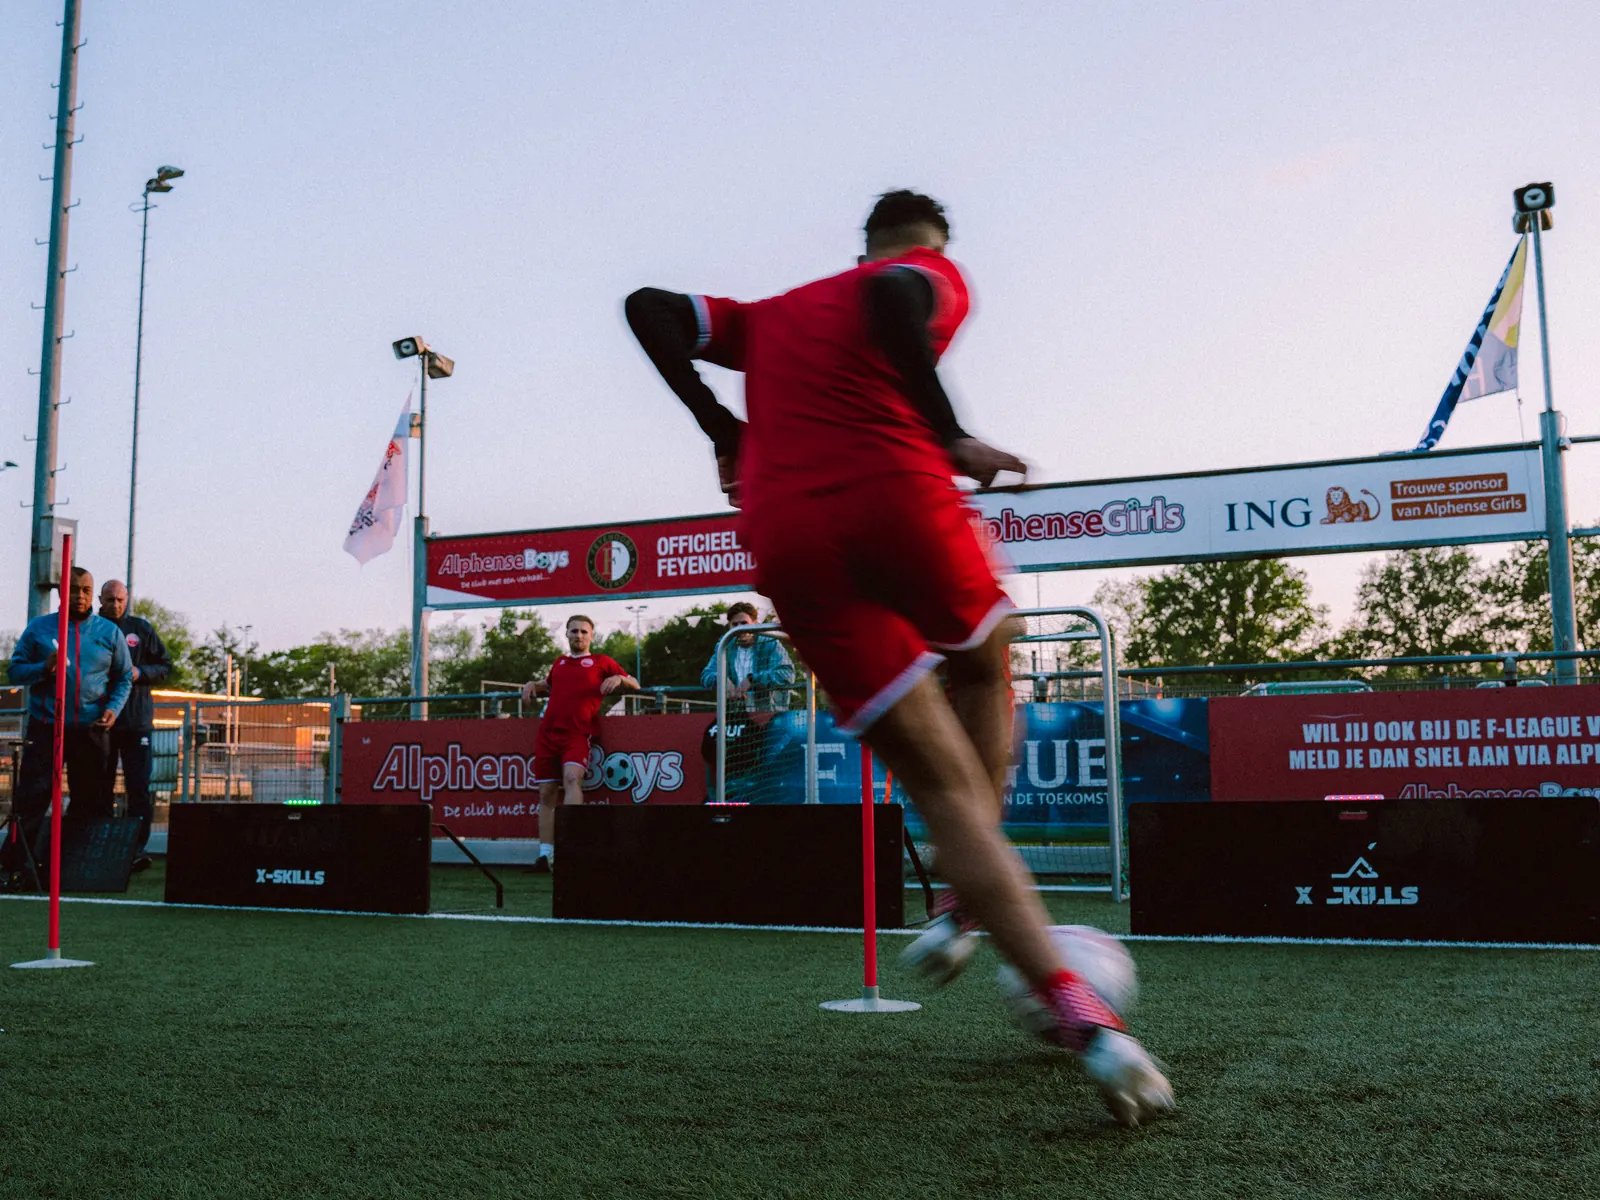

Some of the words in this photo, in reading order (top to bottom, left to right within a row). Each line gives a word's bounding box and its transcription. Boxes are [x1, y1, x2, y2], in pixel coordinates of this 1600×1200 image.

[1394, 482, 1446, 496] Trouwe
[1448, 478, 1504, 493] sponsor
[1224, 497, 1313, 532] ING
[1396, 506, 1421, 517] van
[1424, 501, 1488, 517] Alphense
[1490, 496, 1522, 511] Girls
[656, 530, 742, 556] OFFICIEEL
[1302, 723, 1340, 743] WIL
[1344, 722, 1369, 742] JIJ
[1373, 720, 1416, 742] OOK
[1420, 719, 1450, 740] BIJ
[1456, 719, 1482, 740] DE
[1486, 716, 1582, 739] F-LEAGUE
[1289, 750, 1340, 770] MELD
[1345, 749, 1364, 768] JE
[1369, 748, 1409, 768] DAN
[1414, 747, 1463, 767] SNEL
[1467, 745, 1509, 767] AAN
[1513, 744, 1552, 765] VIA
[443, 806, 460, 817] De
[464, 801, 495, 815] club
[498, 803, 526, 816] met
[1016, 793, 1034, 805] DE
[255, 869, 326, 886] X-SKILLS
[1294, 886, 1313, 905] X
